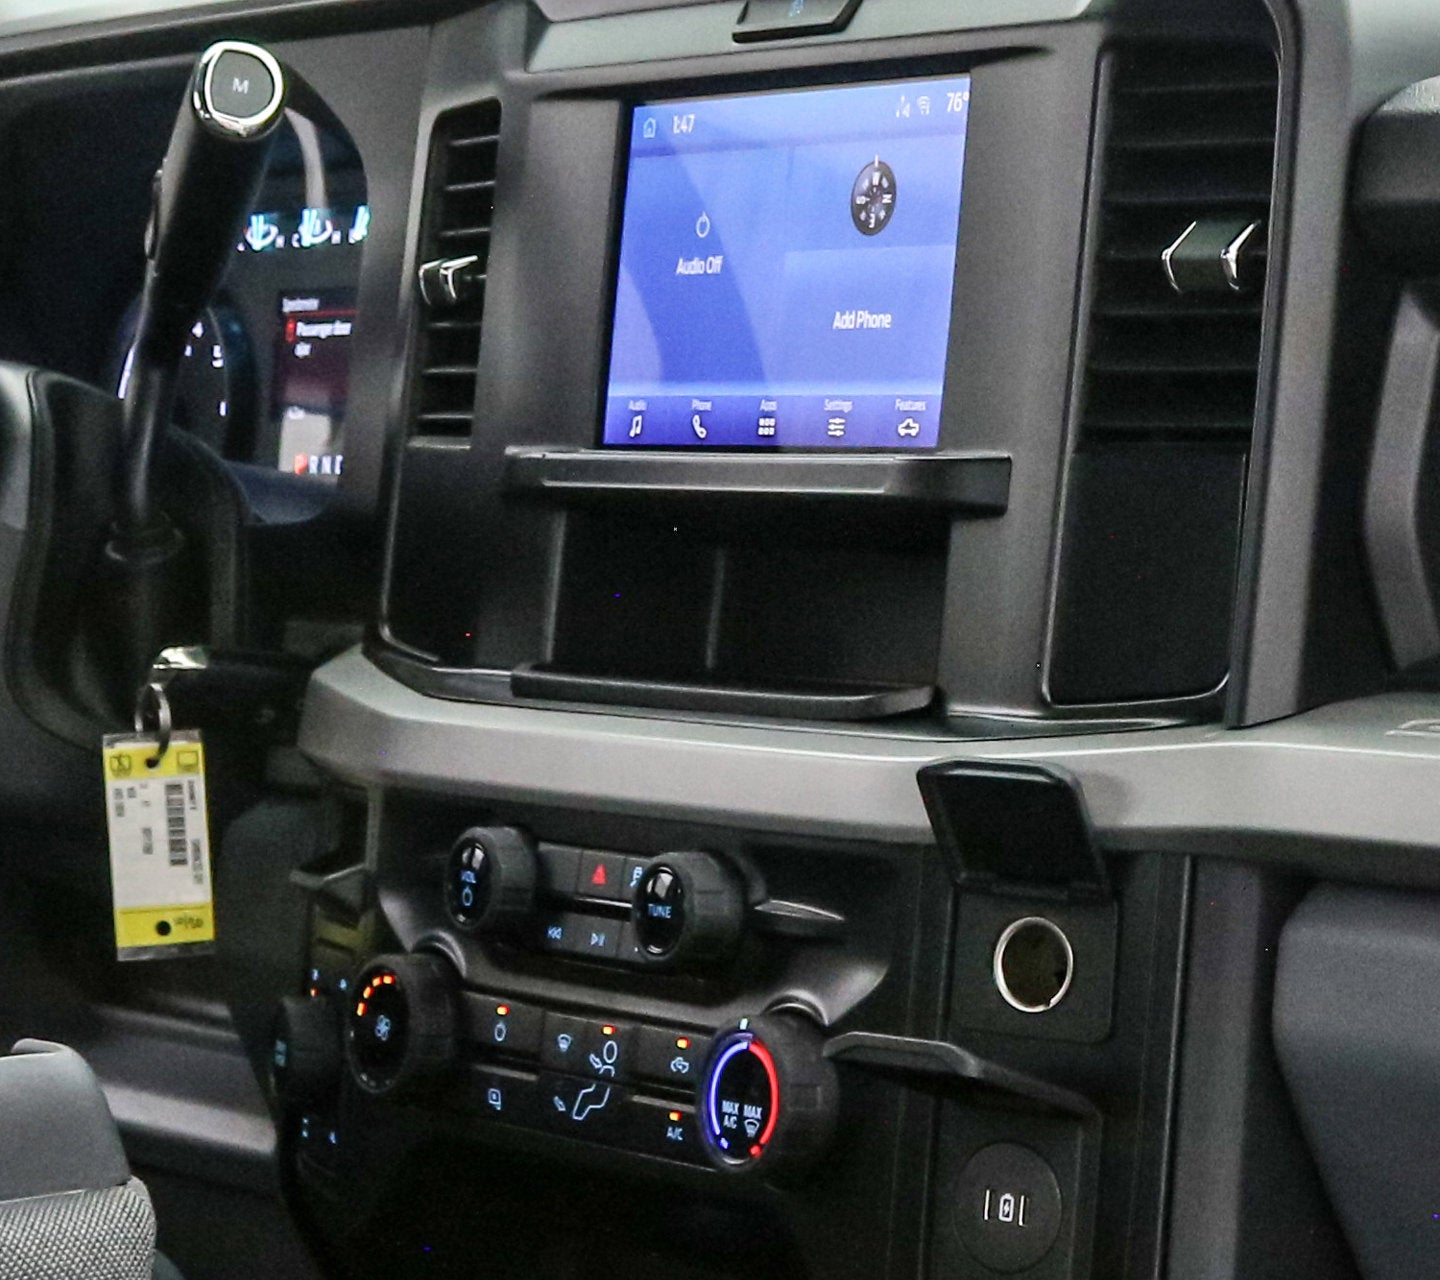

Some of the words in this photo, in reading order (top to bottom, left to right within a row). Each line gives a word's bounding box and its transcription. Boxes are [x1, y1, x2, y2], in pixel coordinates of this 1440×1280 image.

[232, 77, 249, 94] M
[676, 257, 705, 275] Audio
[706, 255, 724, 274] Off
[833, 310, 855, 330] Add
[856, 310, 892, 329] Phone
[628, 399, 647, 411] Audio
[691, 399, 712, 411] Phone
[761, 399, 778, 412] Apps
[824, 399, 853, 413] Settings
[895, 399, 927, 411] Features
[647, 903, 672, 919] TUNE
[721, 1099, 740, 1116] MAX
[743, 1103, 763, 1120] MAX
[723, 1114, 738, 1130] A/C
[666, 1126, 683, 1141] A/C
